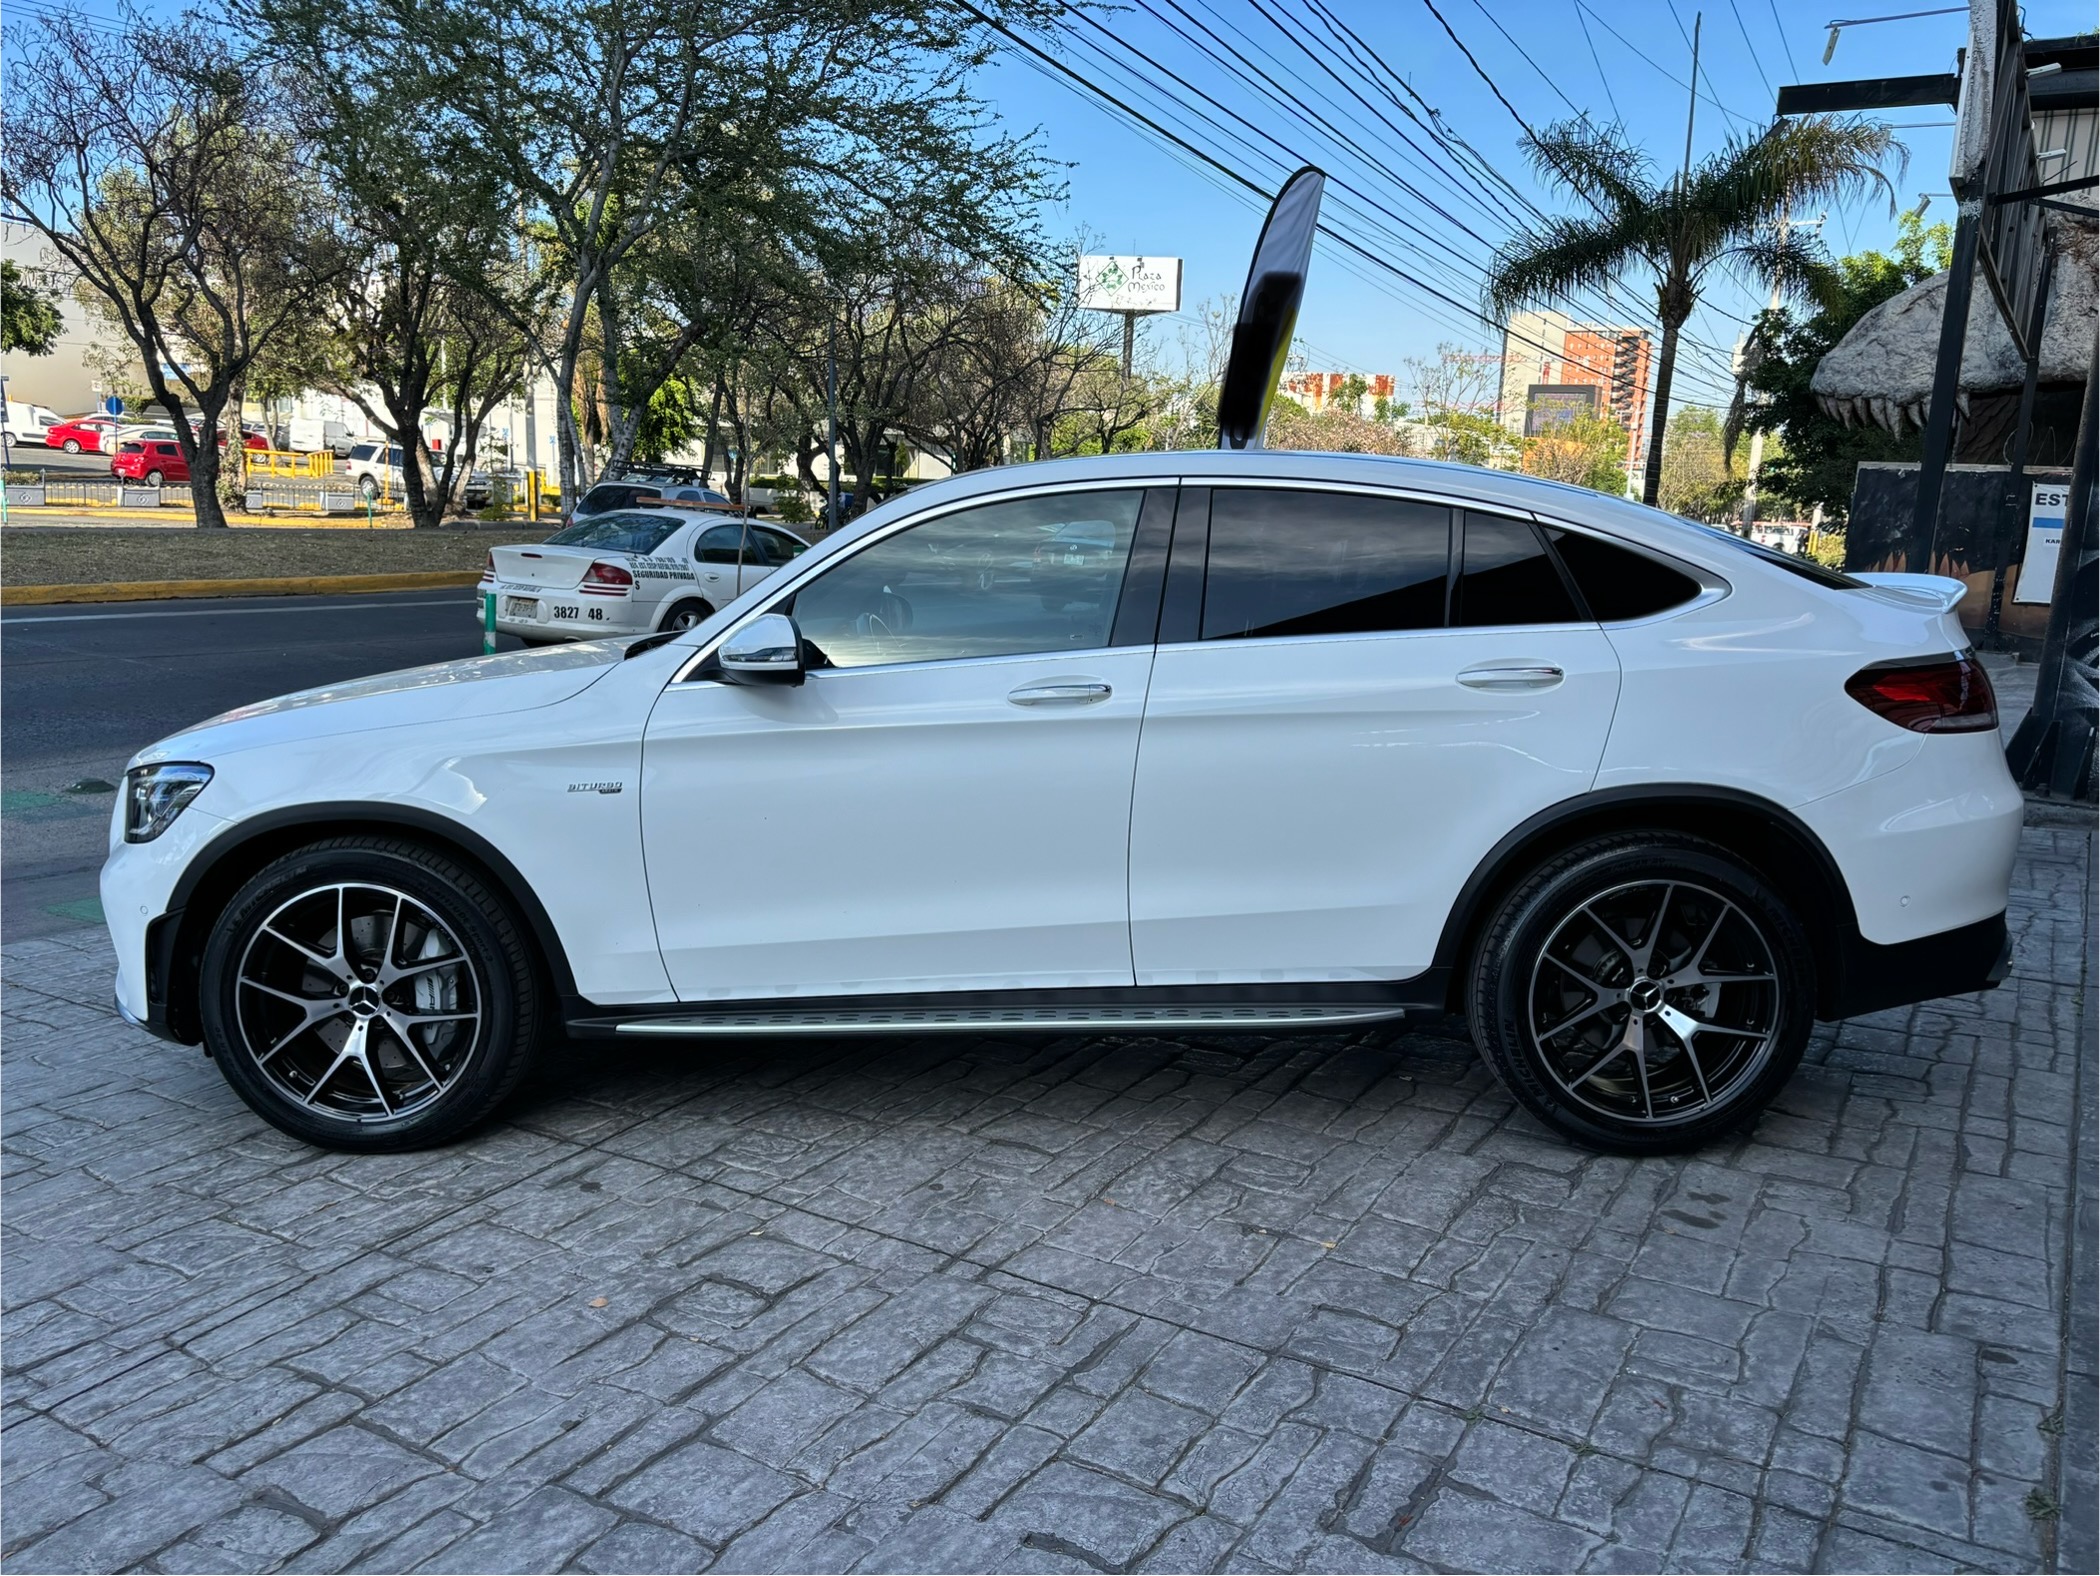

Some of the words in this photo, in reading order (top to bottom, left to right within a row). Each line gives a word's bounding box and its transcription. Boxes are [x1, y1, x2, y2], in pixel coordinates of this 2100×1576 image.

[632, 570, 668, 579] SEGURIDAD
[669, 571, 696, 580] PRIVADA
[553, 606, 579, 619] 3827
[588, 608, 603, 620] 48
[1503, 1018, 1546, 1097] MICHELIN
